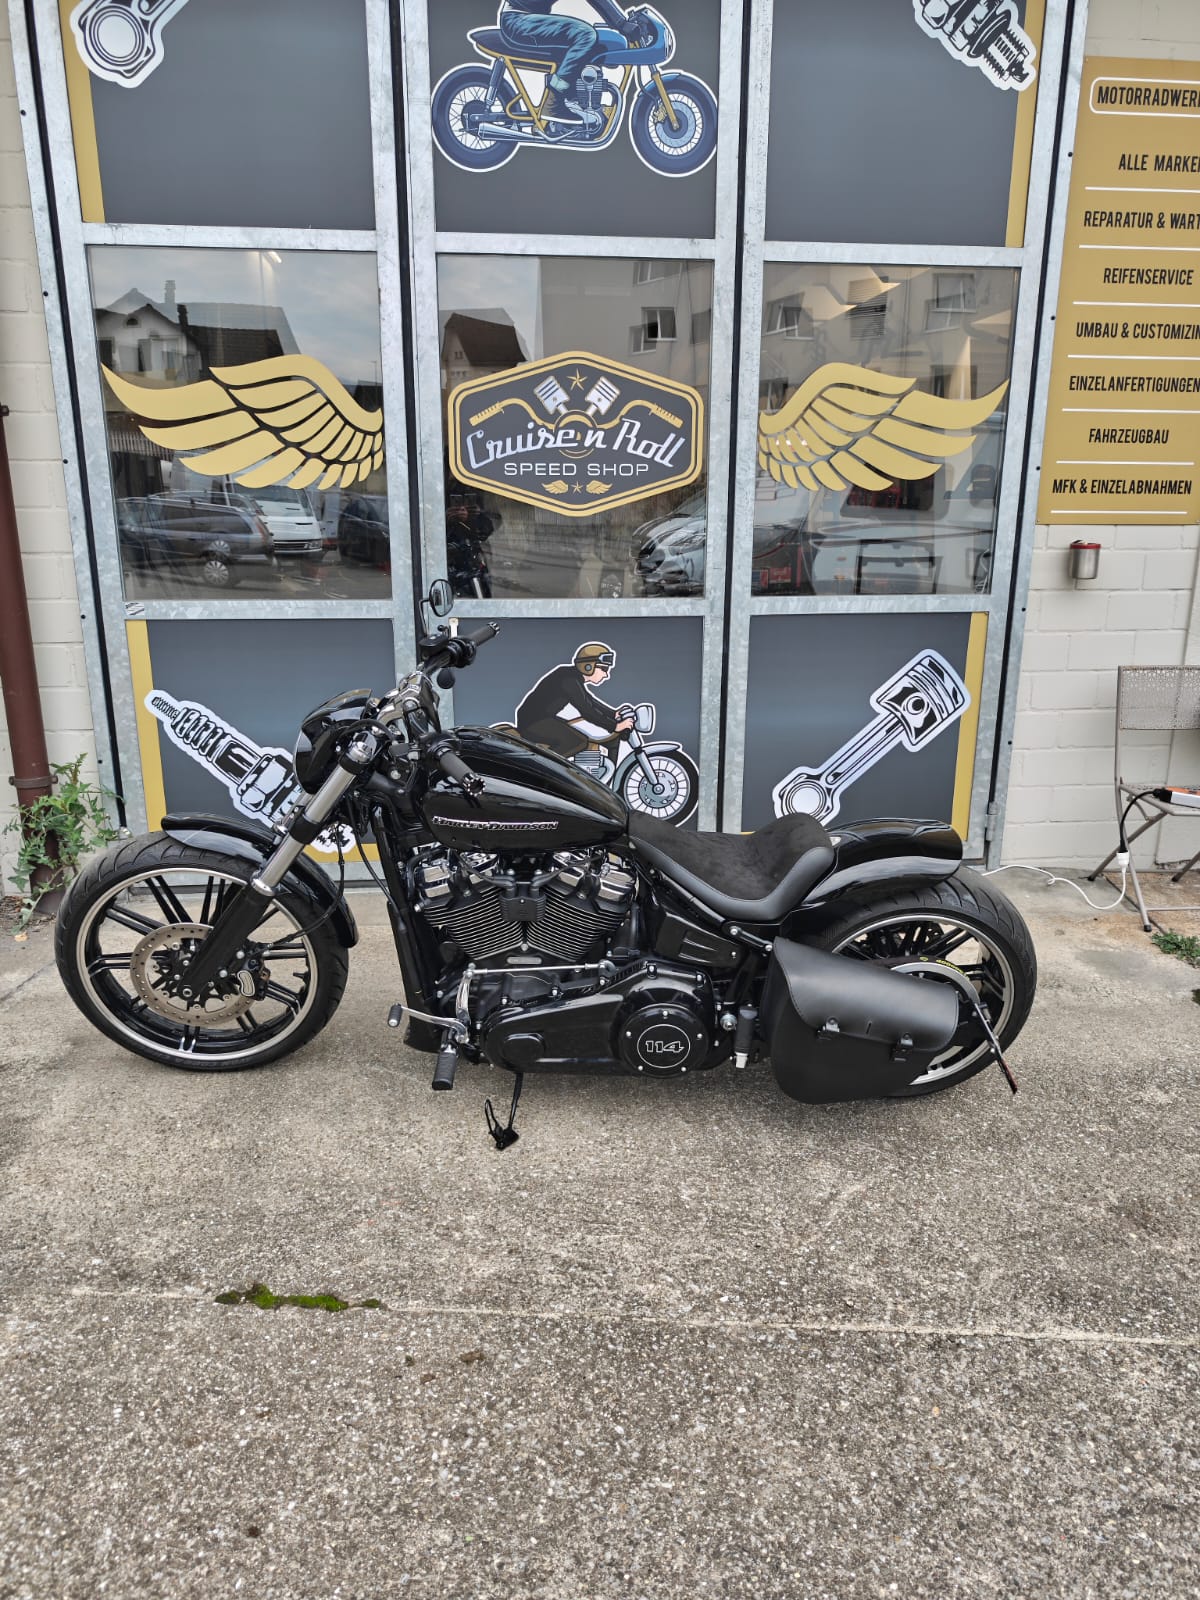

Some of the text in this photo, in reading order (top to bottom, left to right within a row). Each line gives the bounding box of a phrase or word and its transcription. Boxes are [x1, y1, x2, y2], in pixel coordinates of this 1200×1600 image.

[1118, 153, 1149, 171] ALLE
[1083, 210, 1153, 229] REPARATUR
[1156, 212, 1166, 229] &
[1103, 267, 1194, 285] REIFENSERVICE
[1076, 322, 1118, 338] UMBAU
[1120, 322, 1130, 339] &
[1069, 375, 1200, 393] EINZELANFERTIGUNGEN
[466, 417, 686, 470] Cruise n Roll
[1088, 428, 1170, 444] FAHRZEUGBAU
[504, 462, 649, 477] SPEED SHOP
[1052, 478, 1193, 495] MFK & EINZELABNAHMEN
[645, 1040, 685, 1053] 114
